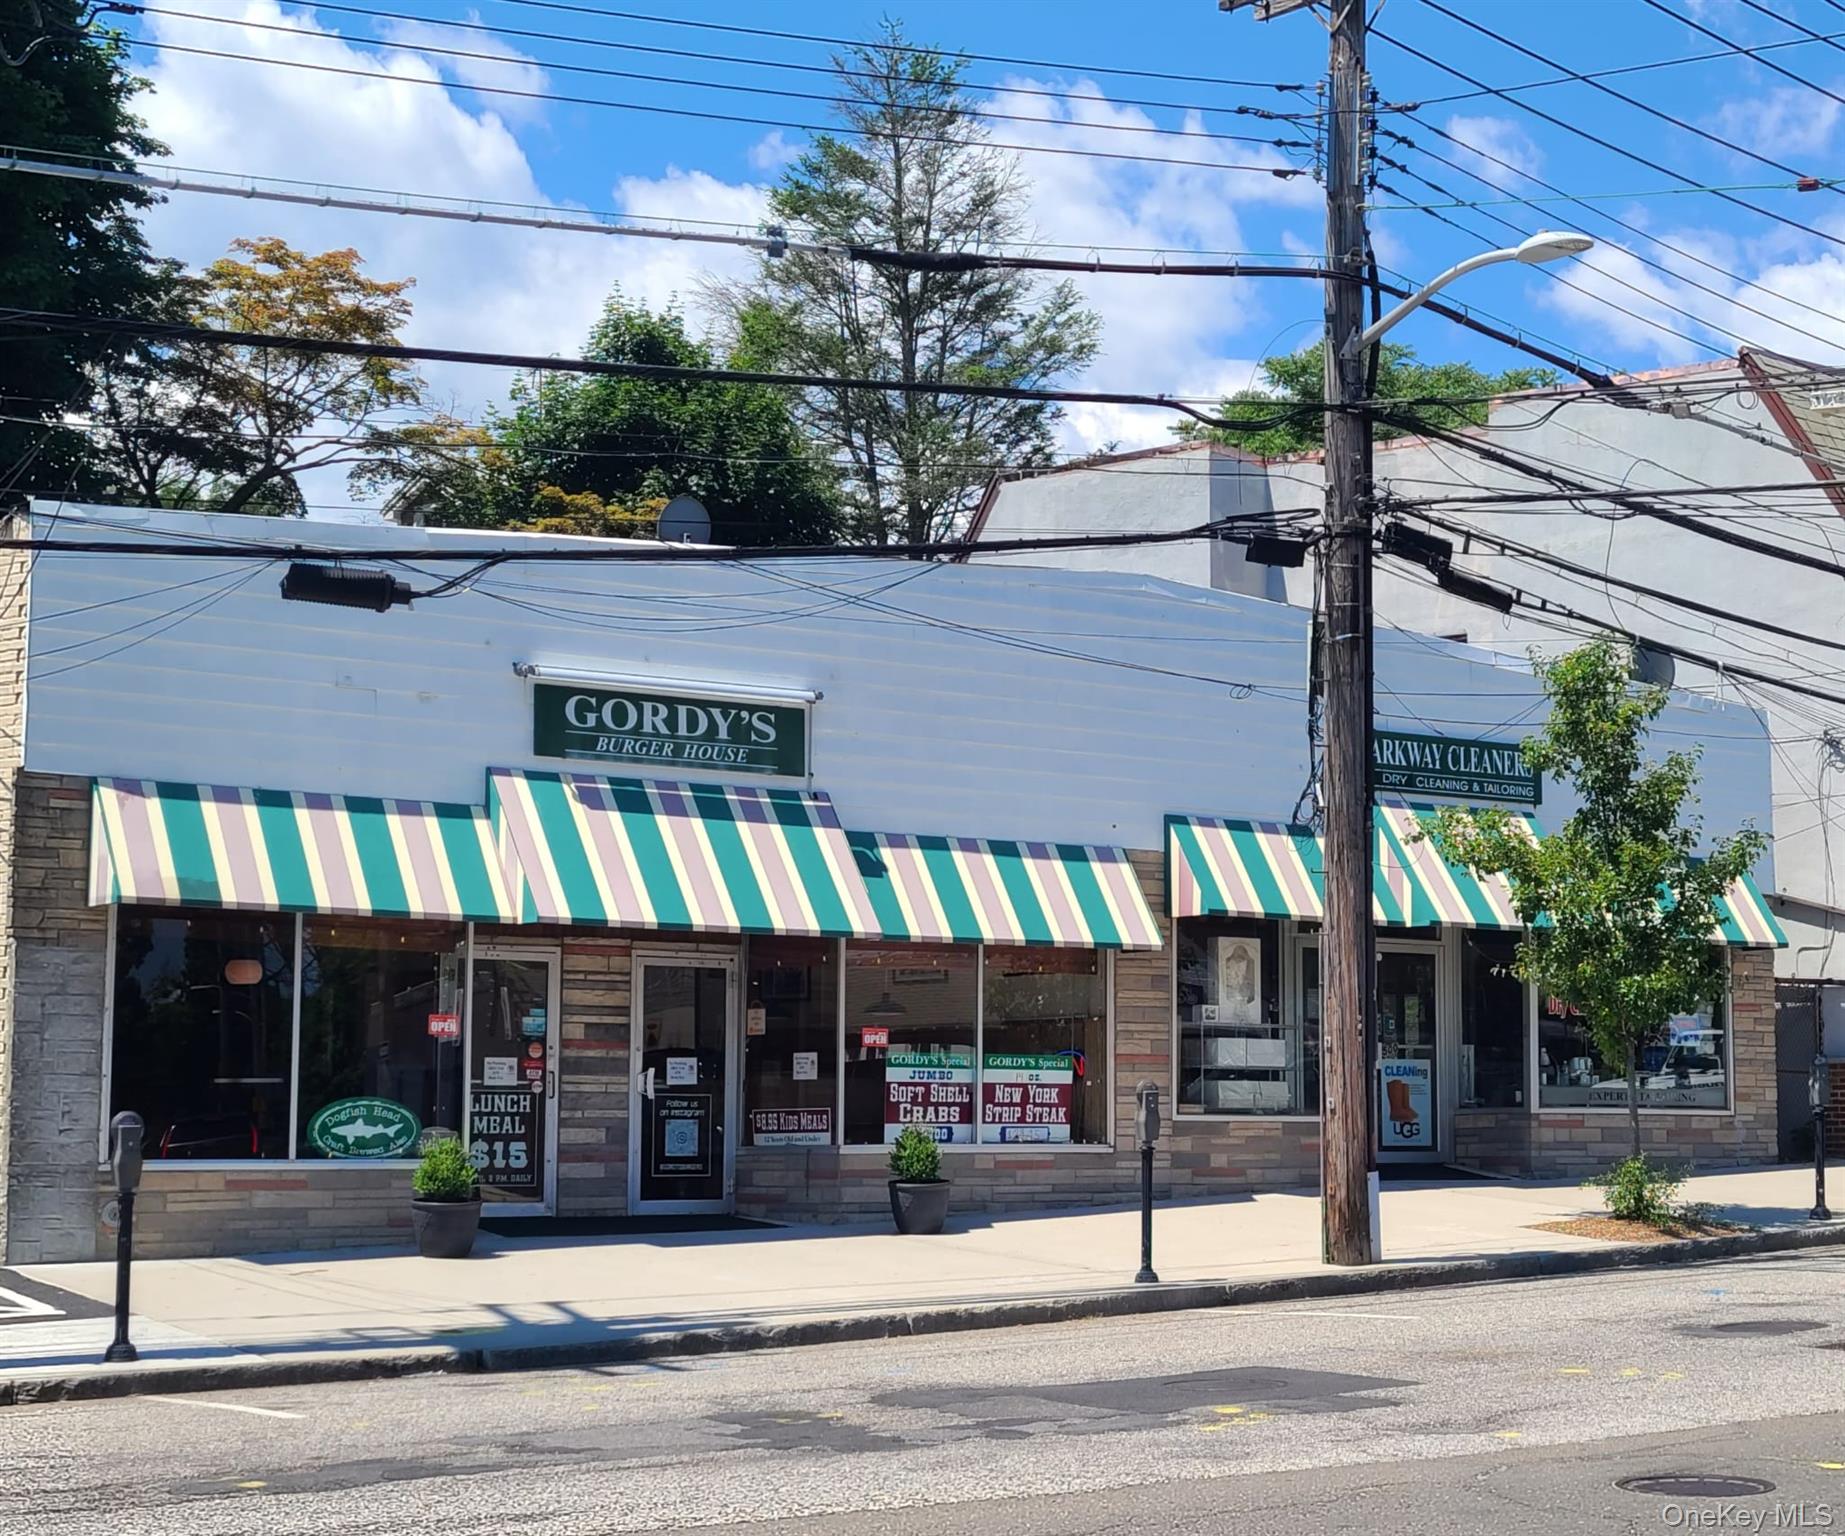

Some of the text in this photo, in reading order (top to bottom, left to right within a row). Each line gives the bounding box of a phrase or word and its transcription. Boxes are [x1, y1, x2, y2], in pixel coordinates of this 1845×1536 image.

[564, 695, 777, 743] GORDY'S
[595, 737, 749, 763] BURGER HOUSE
[1373, 737, 1444, 769] ARKWAY
[1382, 773, 1534, 797] DRY CLEANING & TAILORING
[431, 1020, 457, 1032] OPEN
[864, 1033, 888, 1044] OPEN
[891, 1055, 970, 1068] GORDY'S Special
[989, 1057, 1068, 1069] GORDY'S Special
[909, 1070, 953, 1080] JUMBO
[1385, 1066, 1428, 1079] CLEANing
[890, 1083, 970, 1103] SOFT SHELL
[994, 1084, 1059, 1103] NEW YORK
[470, 1094, 531, 1112] LUNCH
[666, 1100, 688, 1108] Follow
[324, 1106, 401, 1127] Dogfish Head
[780, 1112, 798, 1130] KIDS
[800, 1112, 827, 1130] MEALS
[899, 1103, 961, 1122] CRABS
[985, 1104, 1067, 1122] STRIP STEAK
[473, 1116, 526, 1134] MEAL
[470, 1138, 528, 1171] $15
[510, 1174, 533, 1183] DAILY
